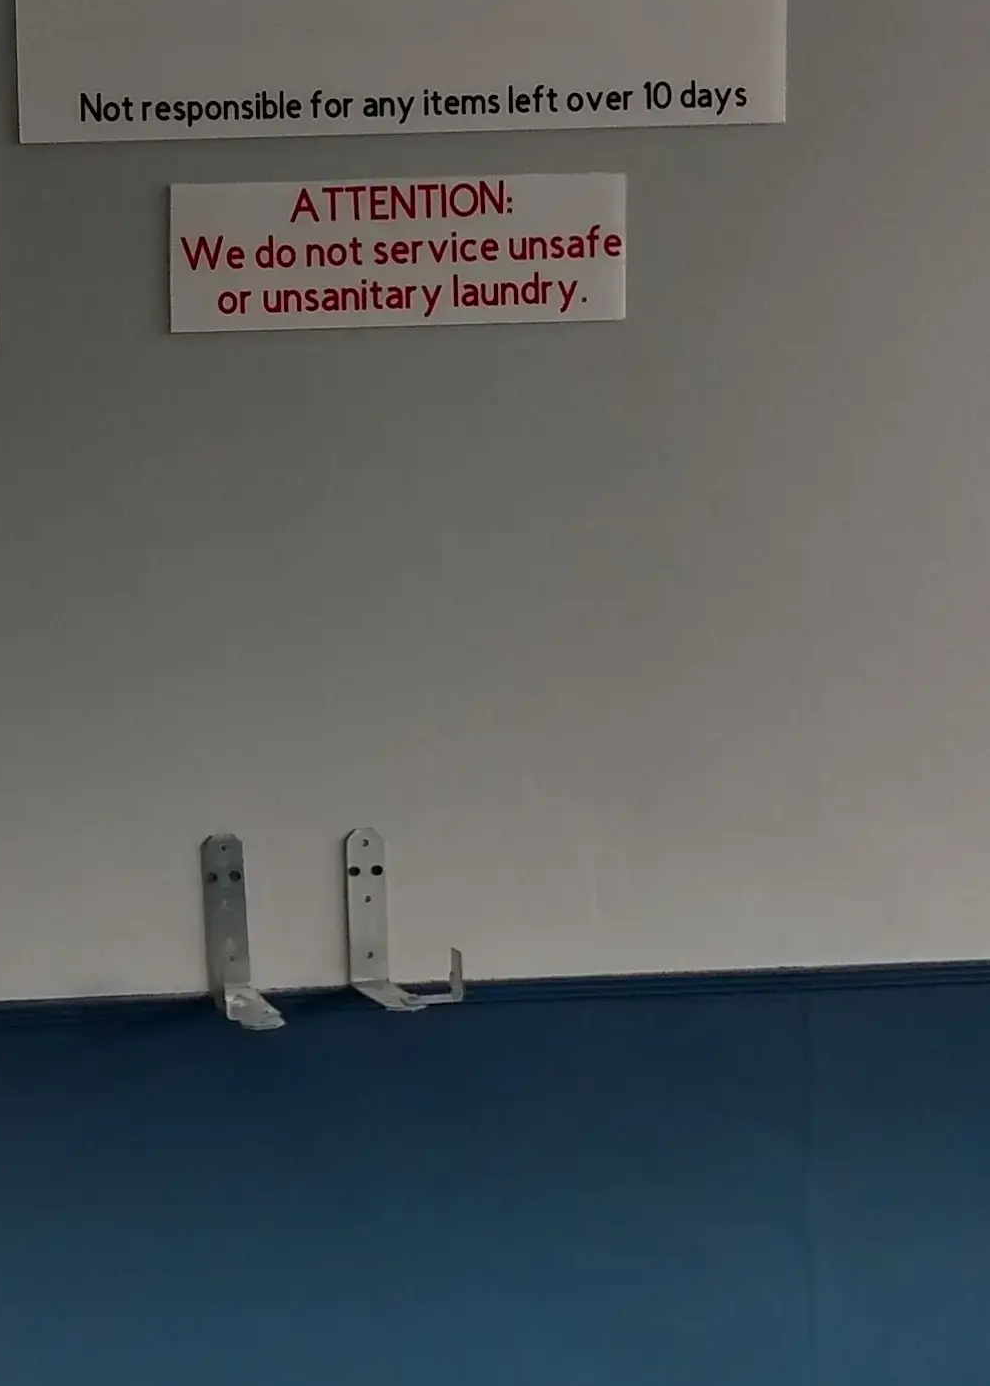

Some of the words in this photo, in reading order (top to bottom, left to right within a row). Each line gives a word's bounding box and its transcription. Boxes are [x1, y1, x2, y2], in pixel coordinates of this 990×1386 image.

[80, 92, 134, 123] Not
[141, 90, 302, 128] responsible
[309, 89, 354, 119] for
[362, 96, 415, 125] any
[423, 88, 501, 117] items
[508, 84, 558, 114] left
[566, 90, 634, 112] over
[643, 81, 672, 110] 10
[680, 79, 748, 116] days
[289, 179, 513, 223] ATTENTION:
[180, 235, 246, 271] We
[255, 234, 297, 269] do
[306, 236, 363, 268] not
[373, 231, 500, 265] service
[508, 224, 622, 261] unsafe
[217, 290, 252, 315] or
[263, 278, 443, 318] unsanitary
[452, 271, 587, 313] laundry.
